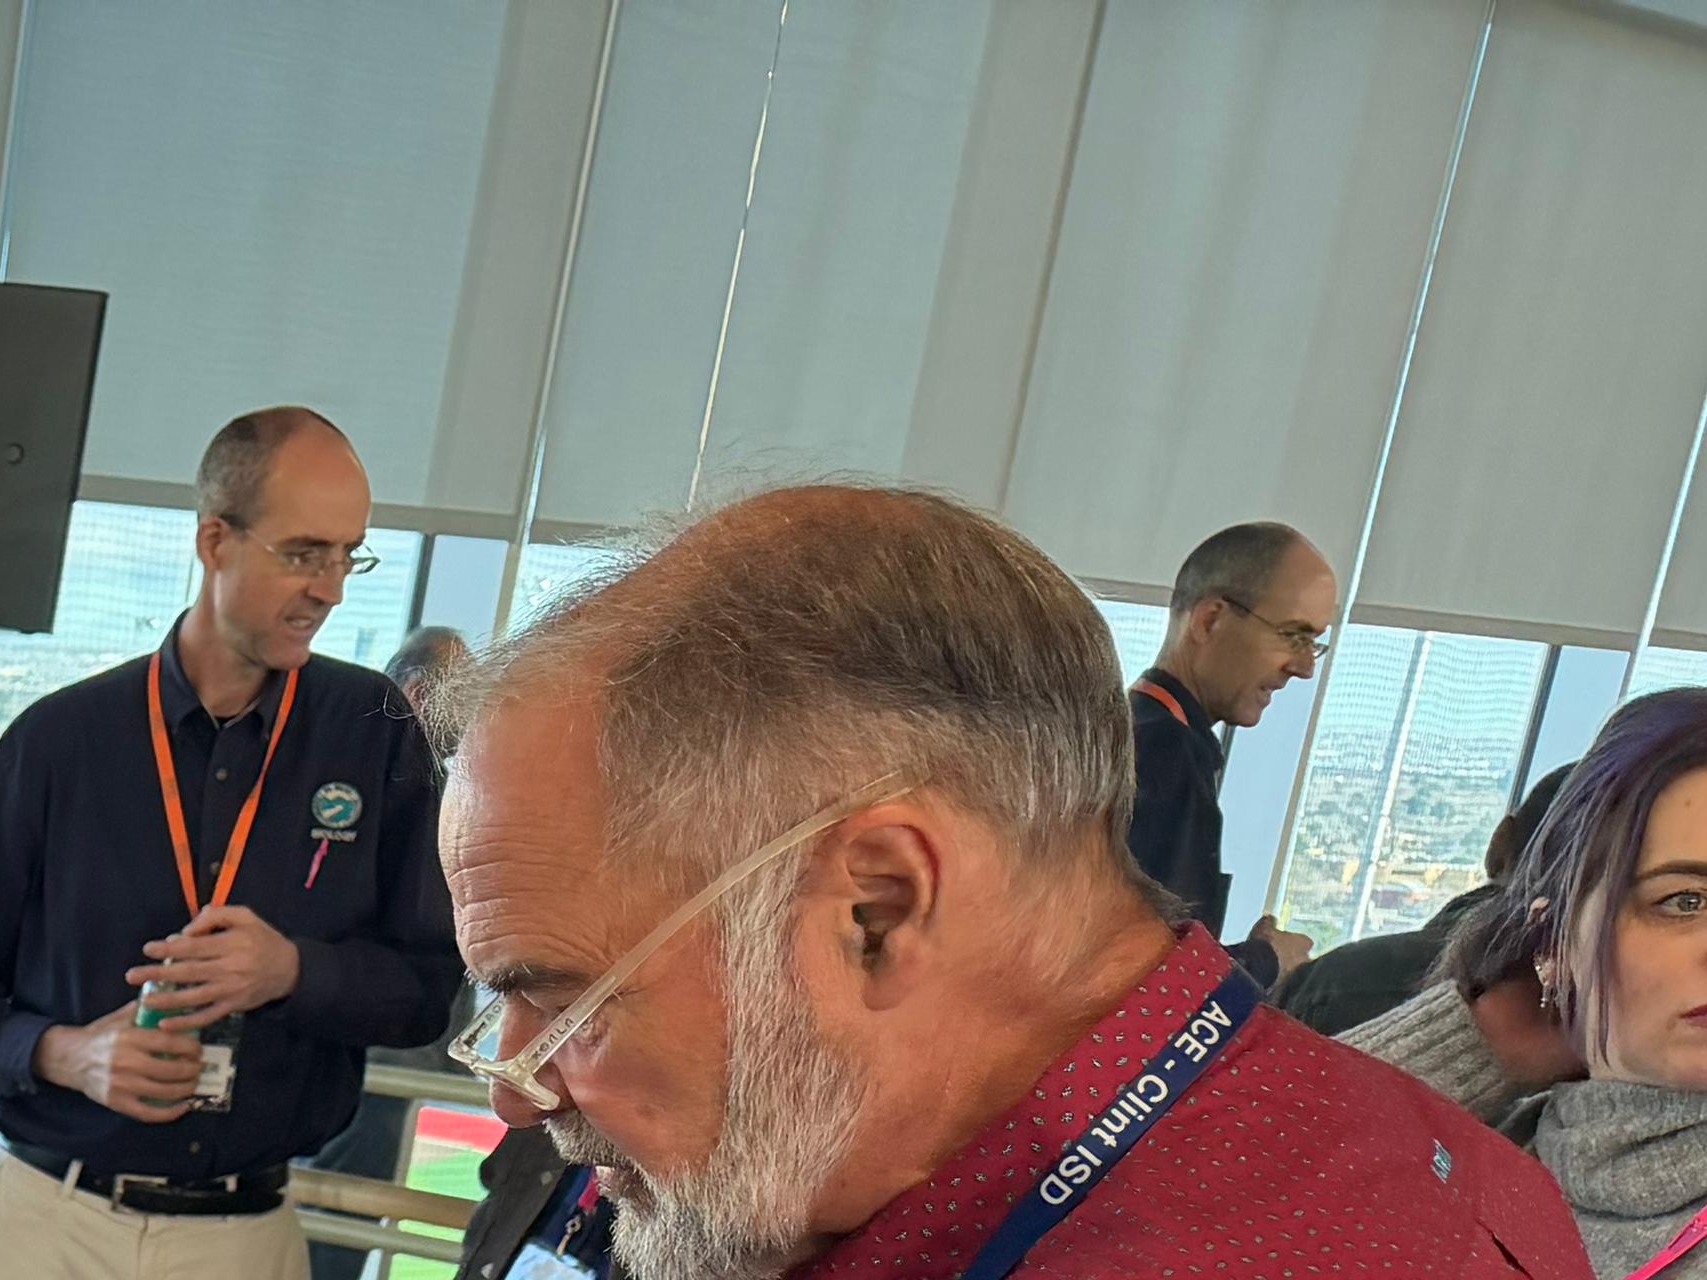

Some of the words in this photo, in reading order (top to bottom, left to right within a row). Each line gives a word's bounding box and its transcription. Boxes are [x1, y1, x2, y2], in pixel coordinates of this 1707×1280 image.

[1174, 1001, 1232, 1062] ACE
[1164, 1059, 1175, 1070] -
[1092, 1074, 1169, 1147] Clint
[1040, 1145, 1102, 1204] ISD
